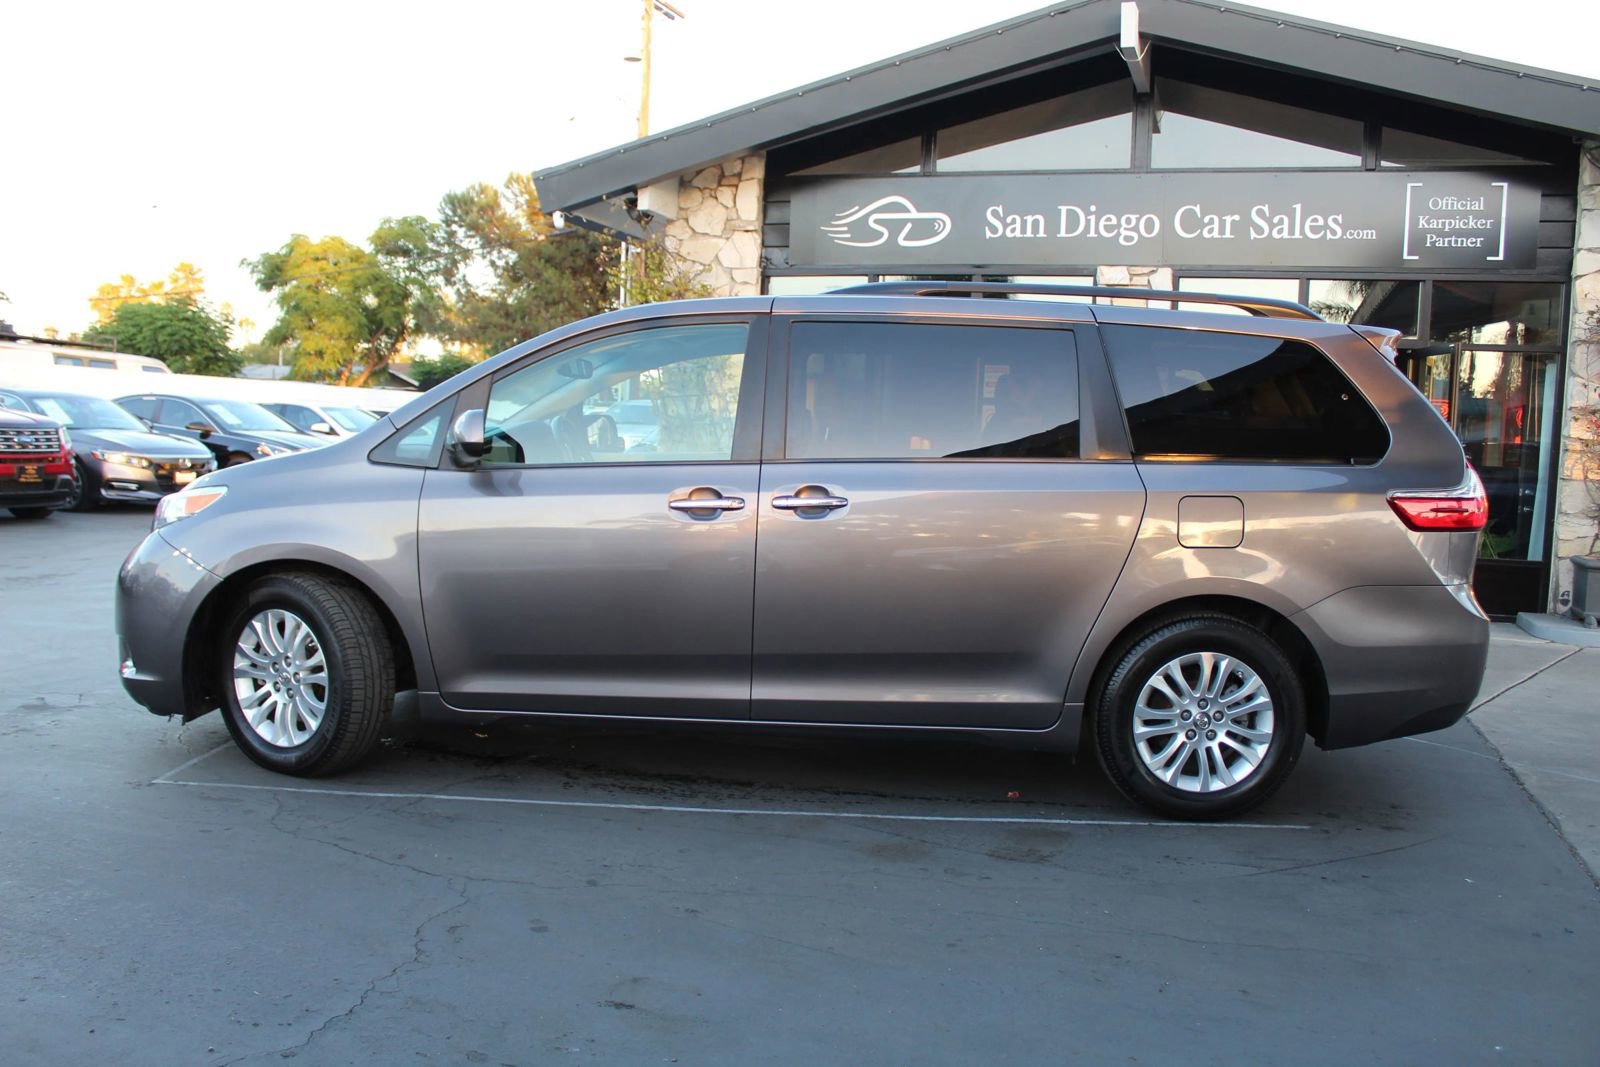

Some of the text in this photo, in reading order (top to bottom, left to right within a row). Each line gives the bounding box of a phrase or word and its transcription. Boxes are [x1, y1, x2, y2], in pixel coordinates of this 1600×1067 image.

[1428, 196, 1485, 211] Official
[984, 204, 1048, 240] San
[1057, 204, 1161, 246] Diego
[1173, 203, 1241, 239] Car
[1417, 215, 1495, 232] Karpicker
[1424, 233, 1485, 248] Partner
